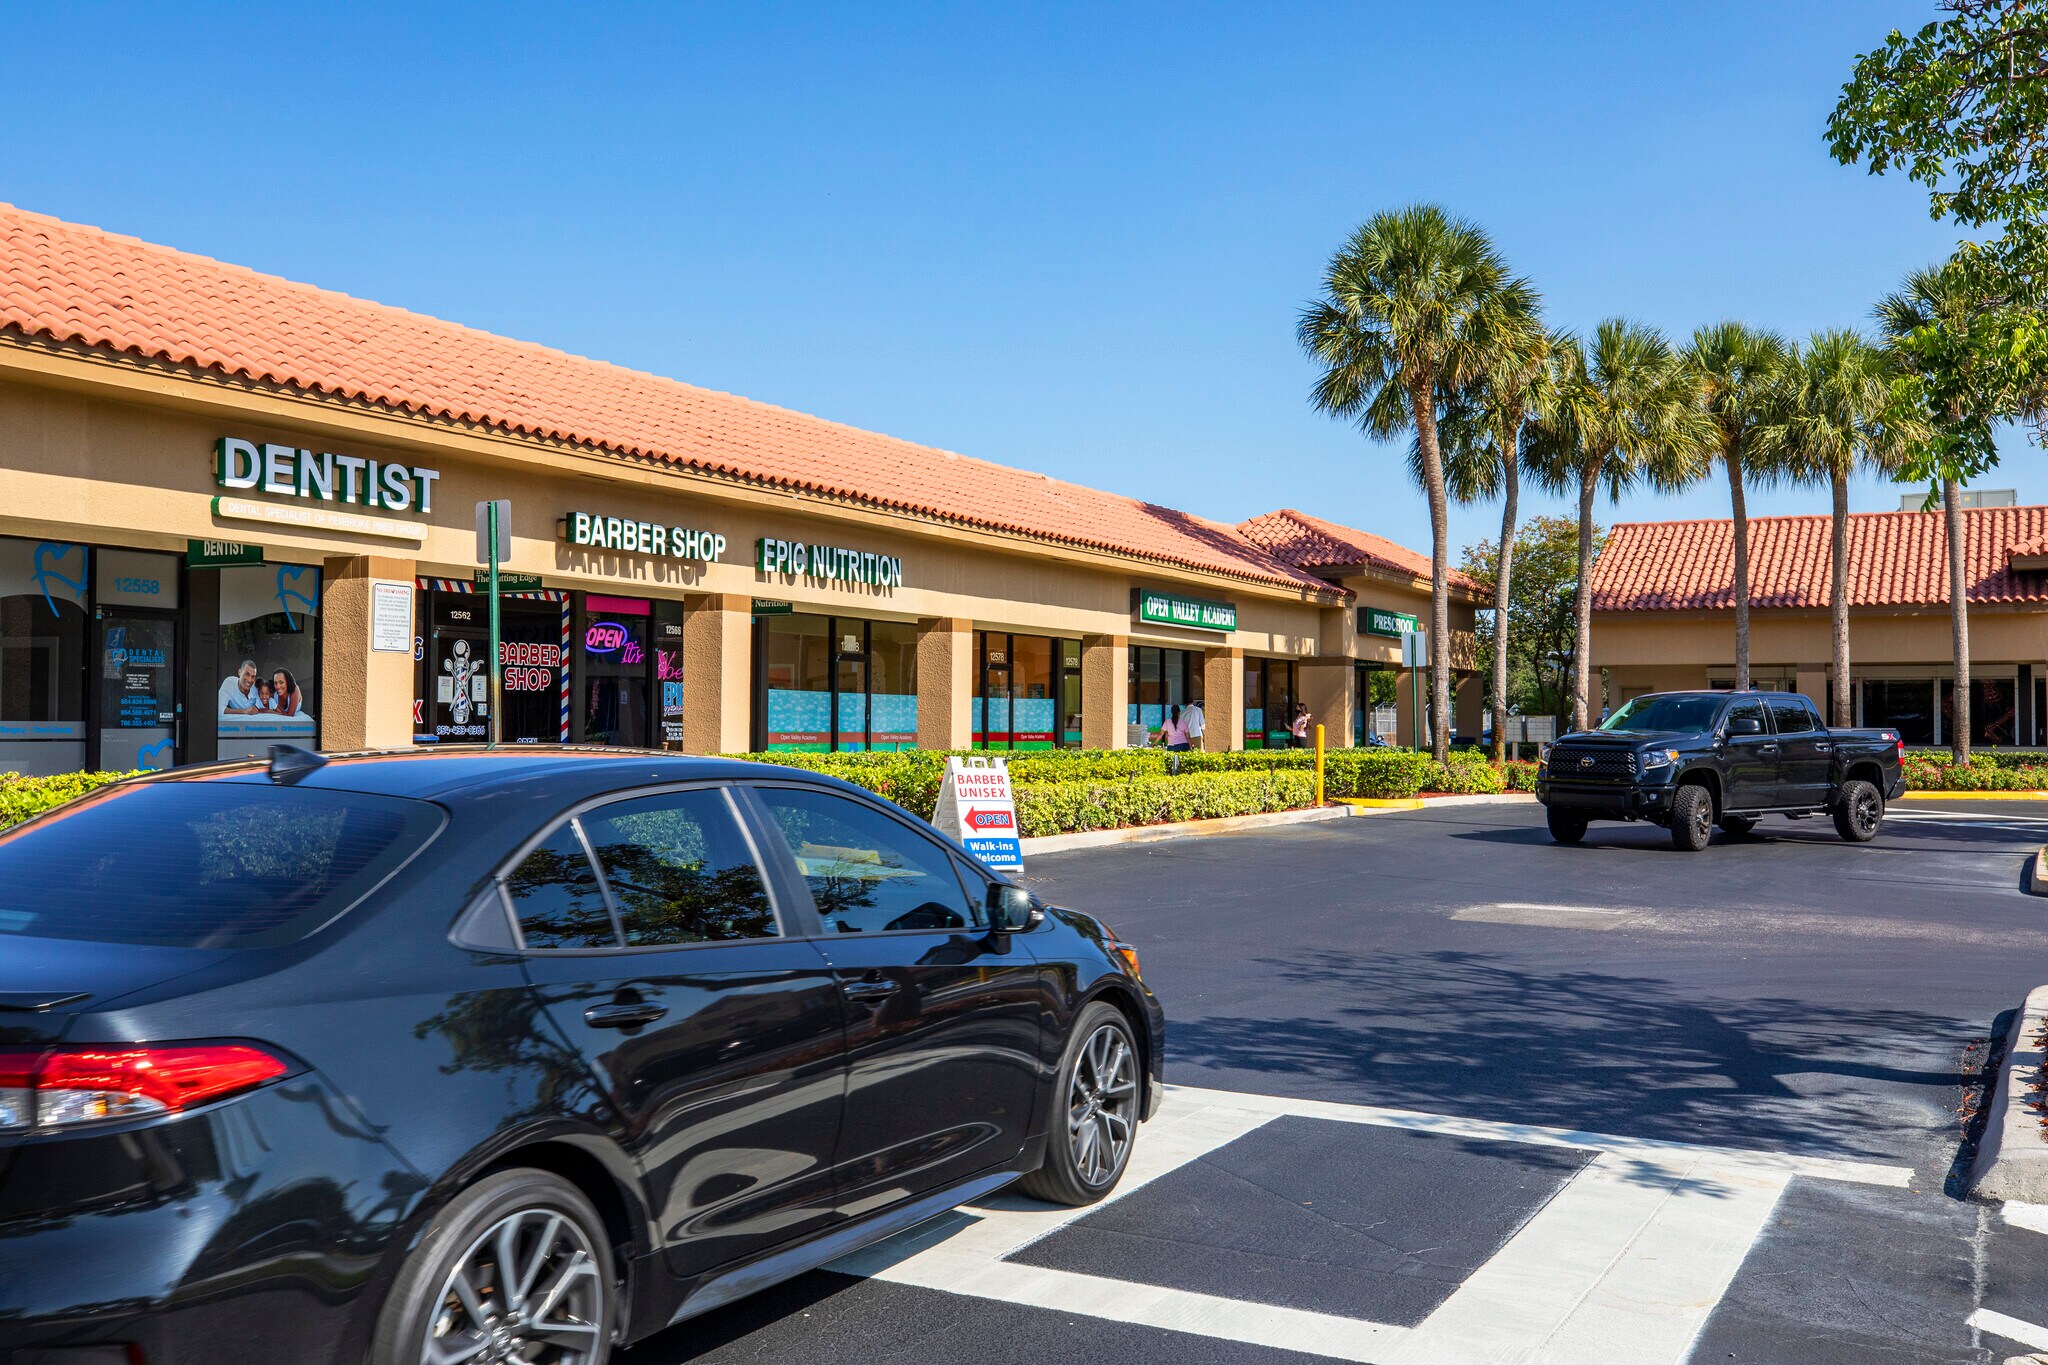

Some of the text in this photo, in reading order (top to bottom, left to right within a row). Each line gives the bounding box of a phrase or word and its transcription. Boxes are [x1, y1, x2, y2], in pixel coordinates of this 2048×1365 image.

[224, 437, 440, 514] DENTIST
[228, 502, 422, 535] DENTAL SPECIALIST OF PEMBROKE PINES GROUP
[575, 511, 727, 562] BARBER SHOP
[204, 541, 244, 556] DENTIST
[763, 538, 902, 588] EPIC NUTRITION
[114, 577, 160, 595] 12558
[476, 575, 490, 583] The
[499, 574, 518, 583] utting
[450, 610, 471, 620] 12562
[1146, 597, 1236, 626] OPEN VALLEY ACADEMY
[1373, 614, 1415, 633] PRESCHOOL
[586, 626, 623, 648] OPEN
[500, 642, 561, 667] BARBER
[621, 641, 645, 663] It's
[990, 652, 1004, 661] 12578
[505, 667, 551, 691] SHOP
[957, 774, 1005, 785] BARBER
[959, 787, 1006, 798] UNISEX
[975, 813, 1010, 826] OPEN
[969, 841, 1014, 851] Walk-ins
